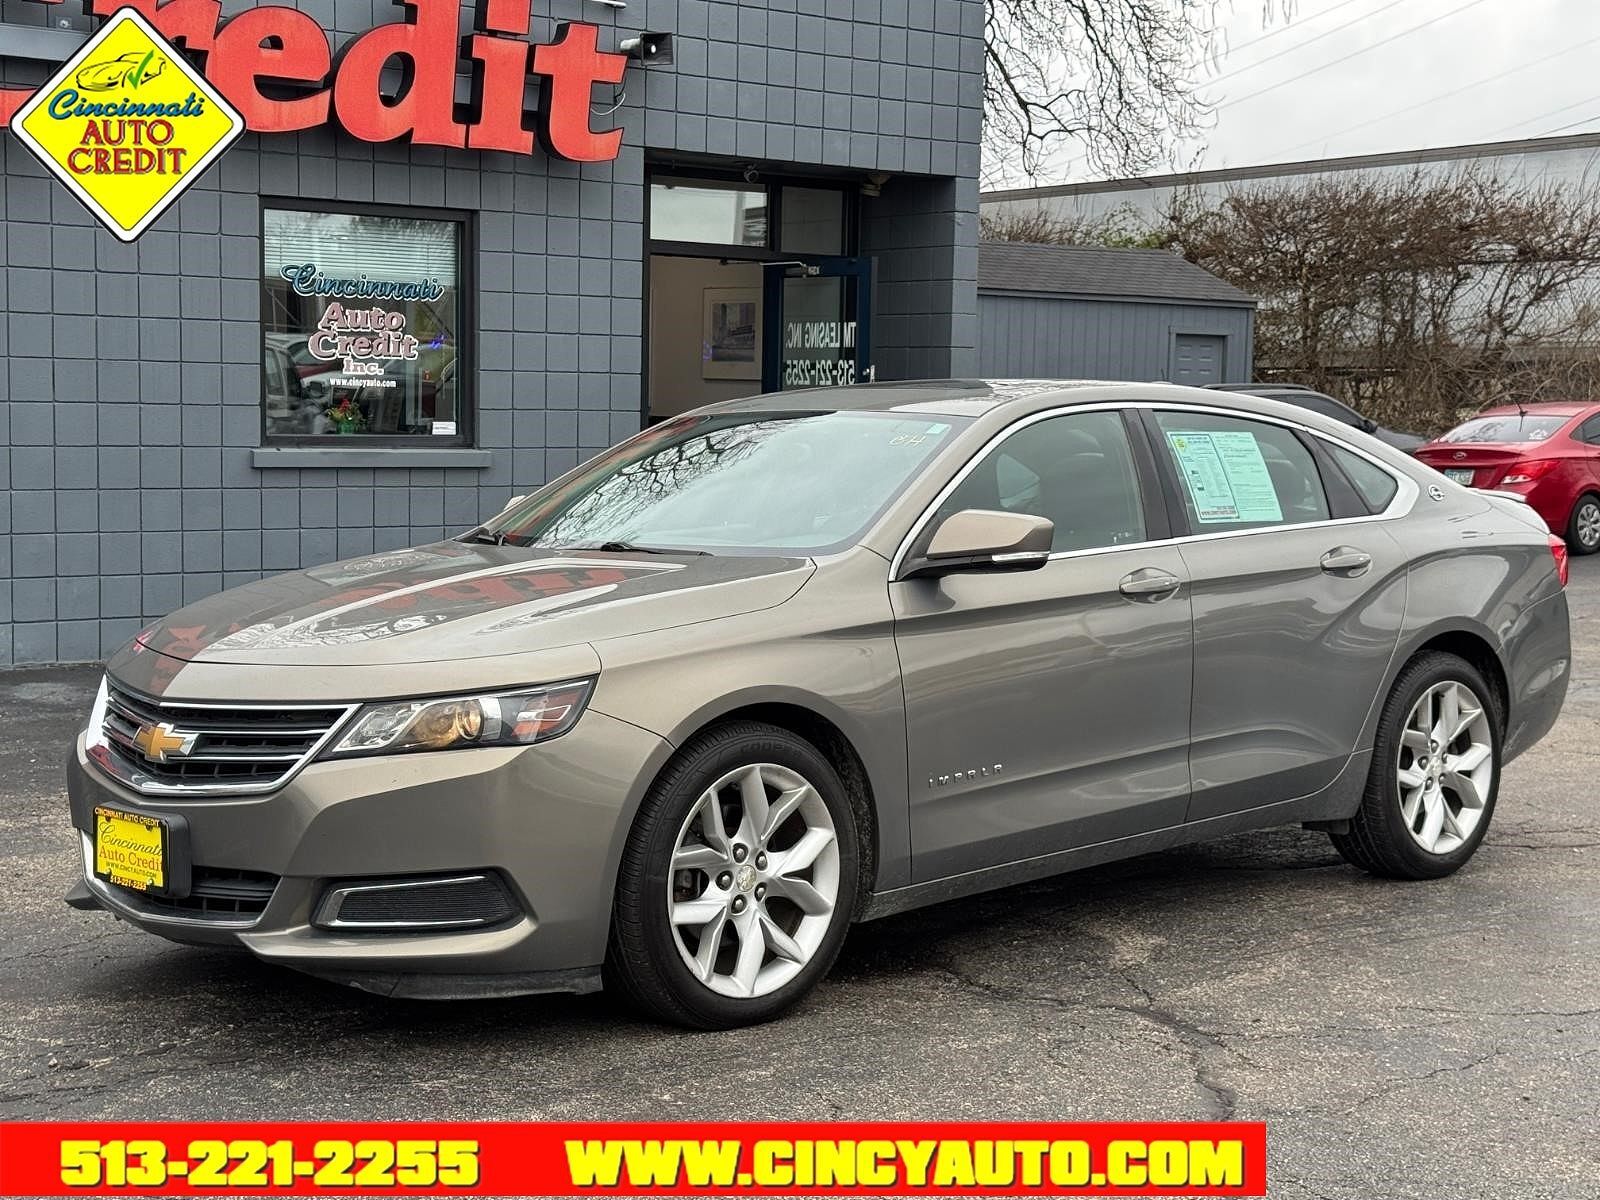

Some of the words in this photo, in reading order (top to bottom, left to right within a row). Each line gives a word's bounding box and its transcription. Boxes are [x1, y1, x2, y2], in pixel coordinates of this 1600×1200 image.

[0, 0, 627, 162] edit
[280, 263, 445, 301] Cincinnati
[317, 302, 406, 332] Auto
[308, 330, 419, 359] Credit
[342, 358, 384, 375] Inc.
[123, 813, 139, 823] AUTO
[98, 845, 125, 863] Auto
[128, 852, 164, 873] Credi
